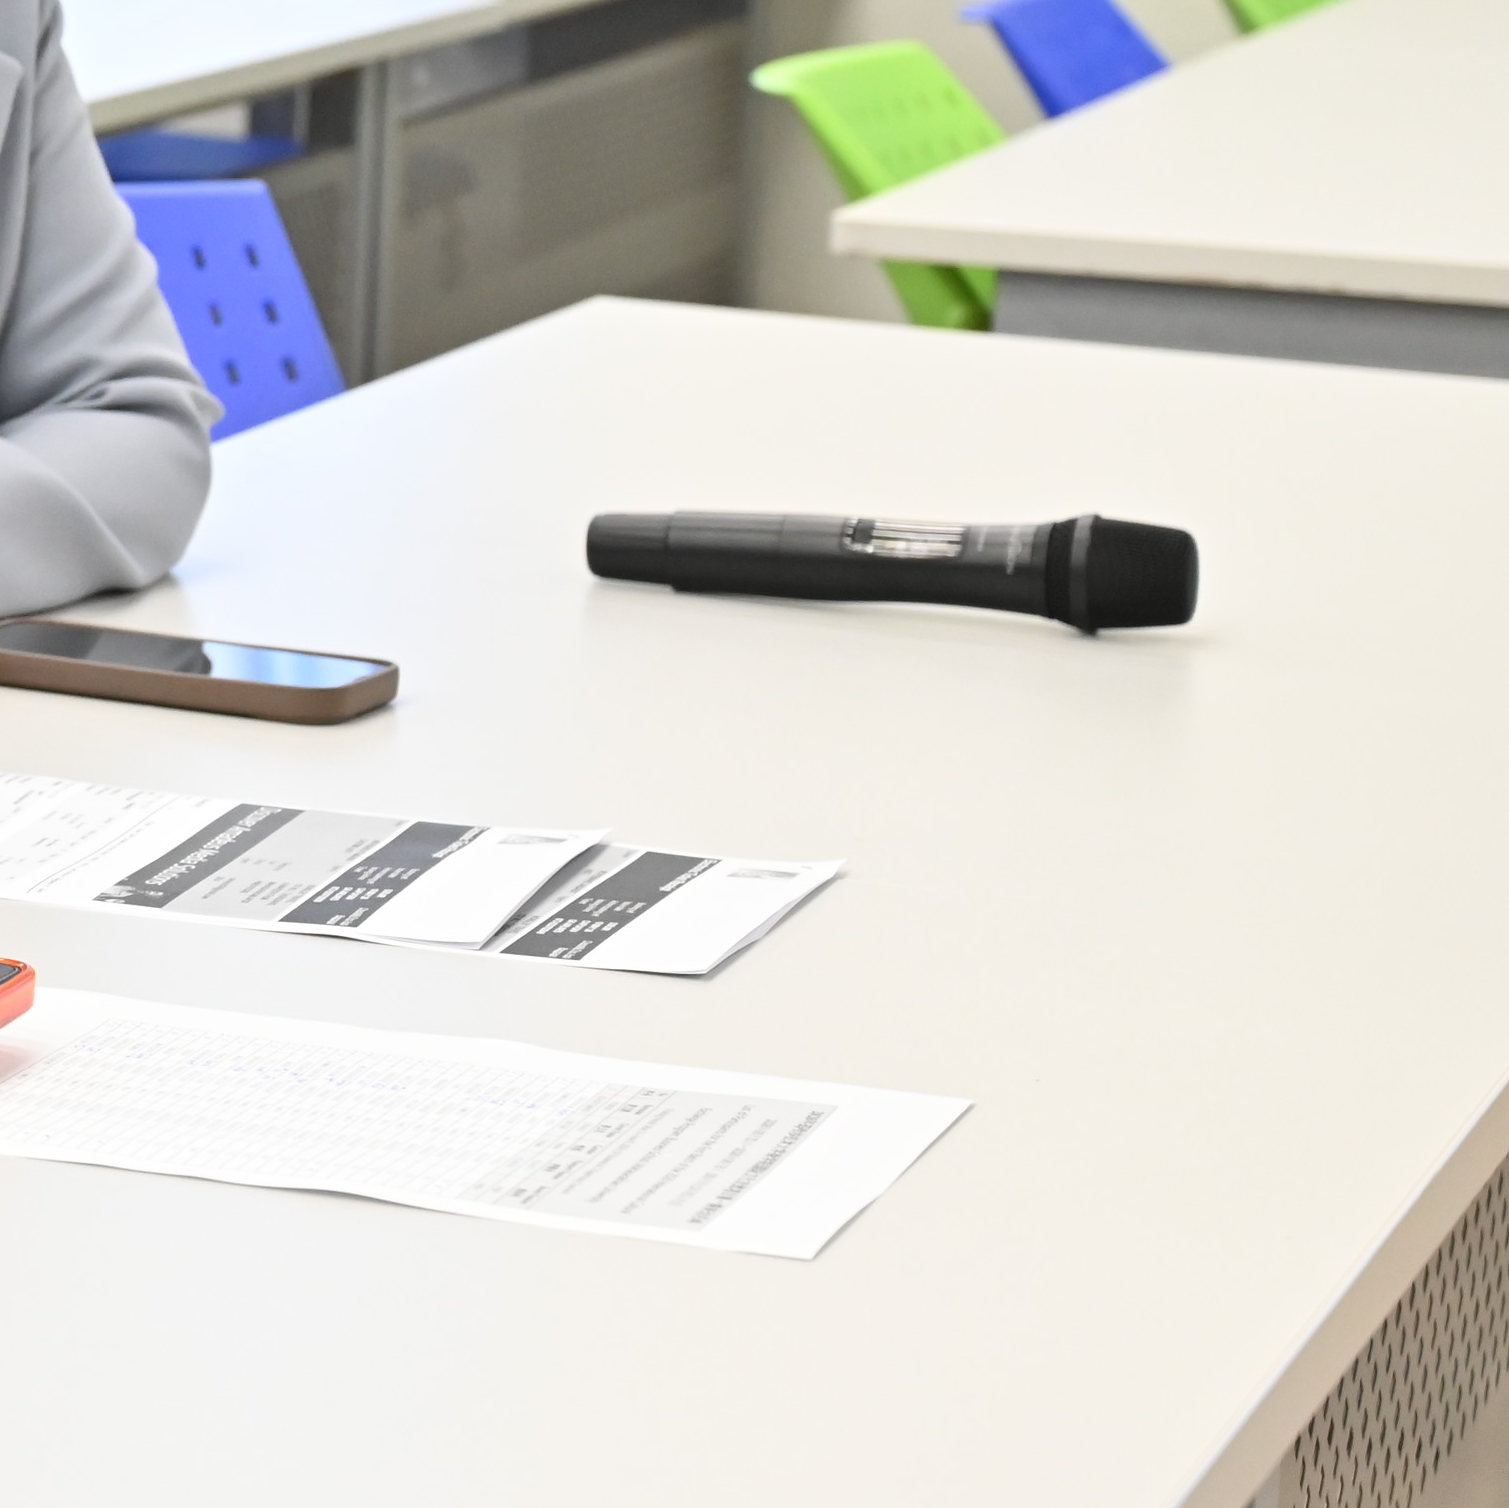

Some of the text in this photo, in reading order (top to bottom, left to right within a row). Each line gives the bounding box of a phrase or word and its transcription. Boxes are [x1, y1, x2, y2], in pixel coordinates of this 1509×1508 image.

[203, 824, 251, 850] Amadeus
[179, 847, 219, 865] Media
[145, 862, 196, 885] Solutions
